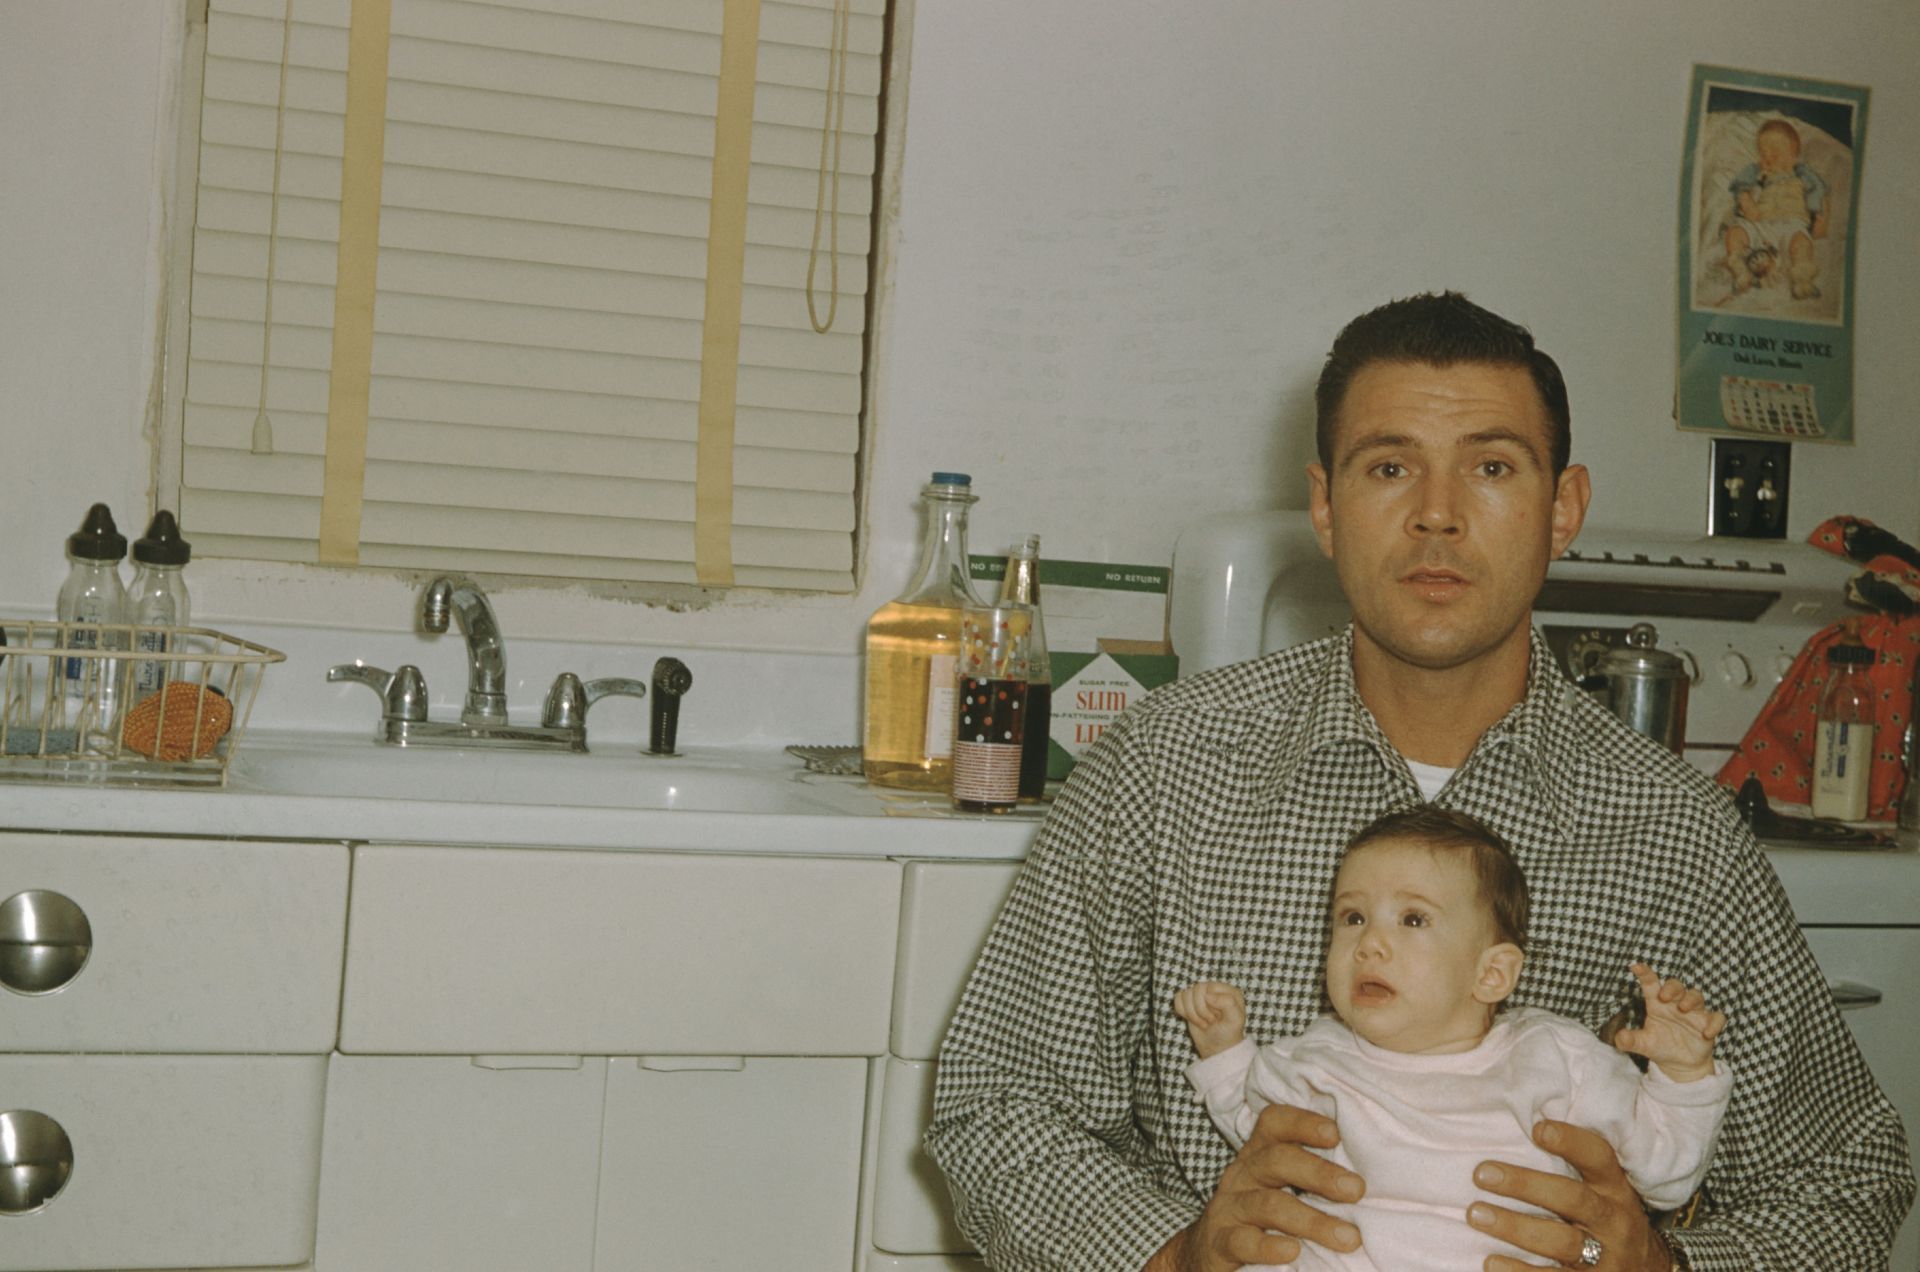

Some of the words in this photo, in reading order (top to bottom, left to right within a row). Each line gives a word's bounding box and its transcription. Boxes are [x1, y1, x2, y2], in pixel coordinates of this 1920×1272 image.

[1703, 331, 1735, 347] JOE'S
[1740, 336, 1777, 351] DAIRY
[1782, 341, 1832, 357] SERVICE
[970, 562, 986, 571] NO
[1105, 572, 1121, 582] NO
[1124, 574, 1161, 584] RETURN
[1078, 679, 1106, 687] SUGAR
